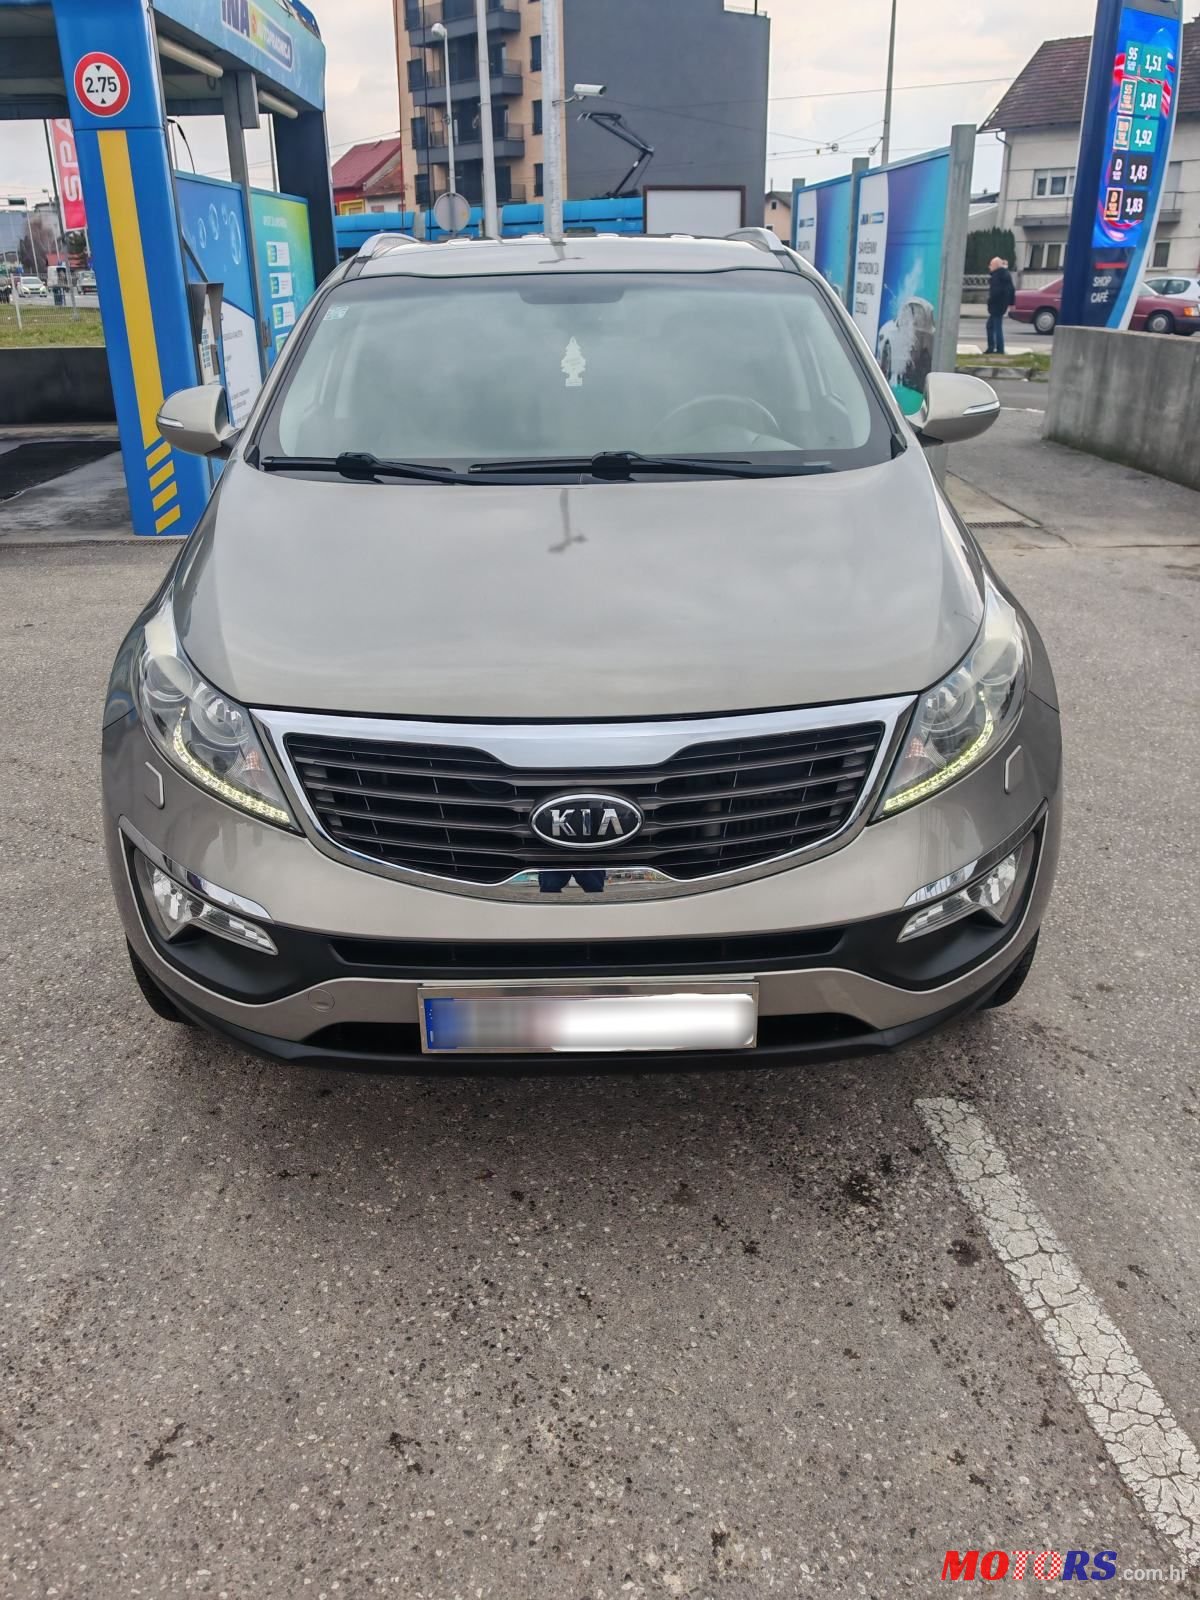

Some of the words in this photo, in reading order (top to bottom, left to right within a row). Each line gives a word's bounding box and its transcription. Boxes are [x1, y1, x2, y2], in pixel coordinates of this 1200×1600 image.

[1128, 47, 1139, 60] 95
[1145, 54, 1162, 73] 1,51
[85, 76, 117, 93] 2.75
[1140, 92, 1157, 111] 1,81
[1135, 129, 1152, 147] 1,92
[1130, 165, 1147, 183] 1,43
[1125, 198, 1143, 215] 1,83
[1092, 276, 1112, 287] SHOP
[1090, 290, 1109, 304] CAFÉ
[550, 808, 624, 836] KIA
